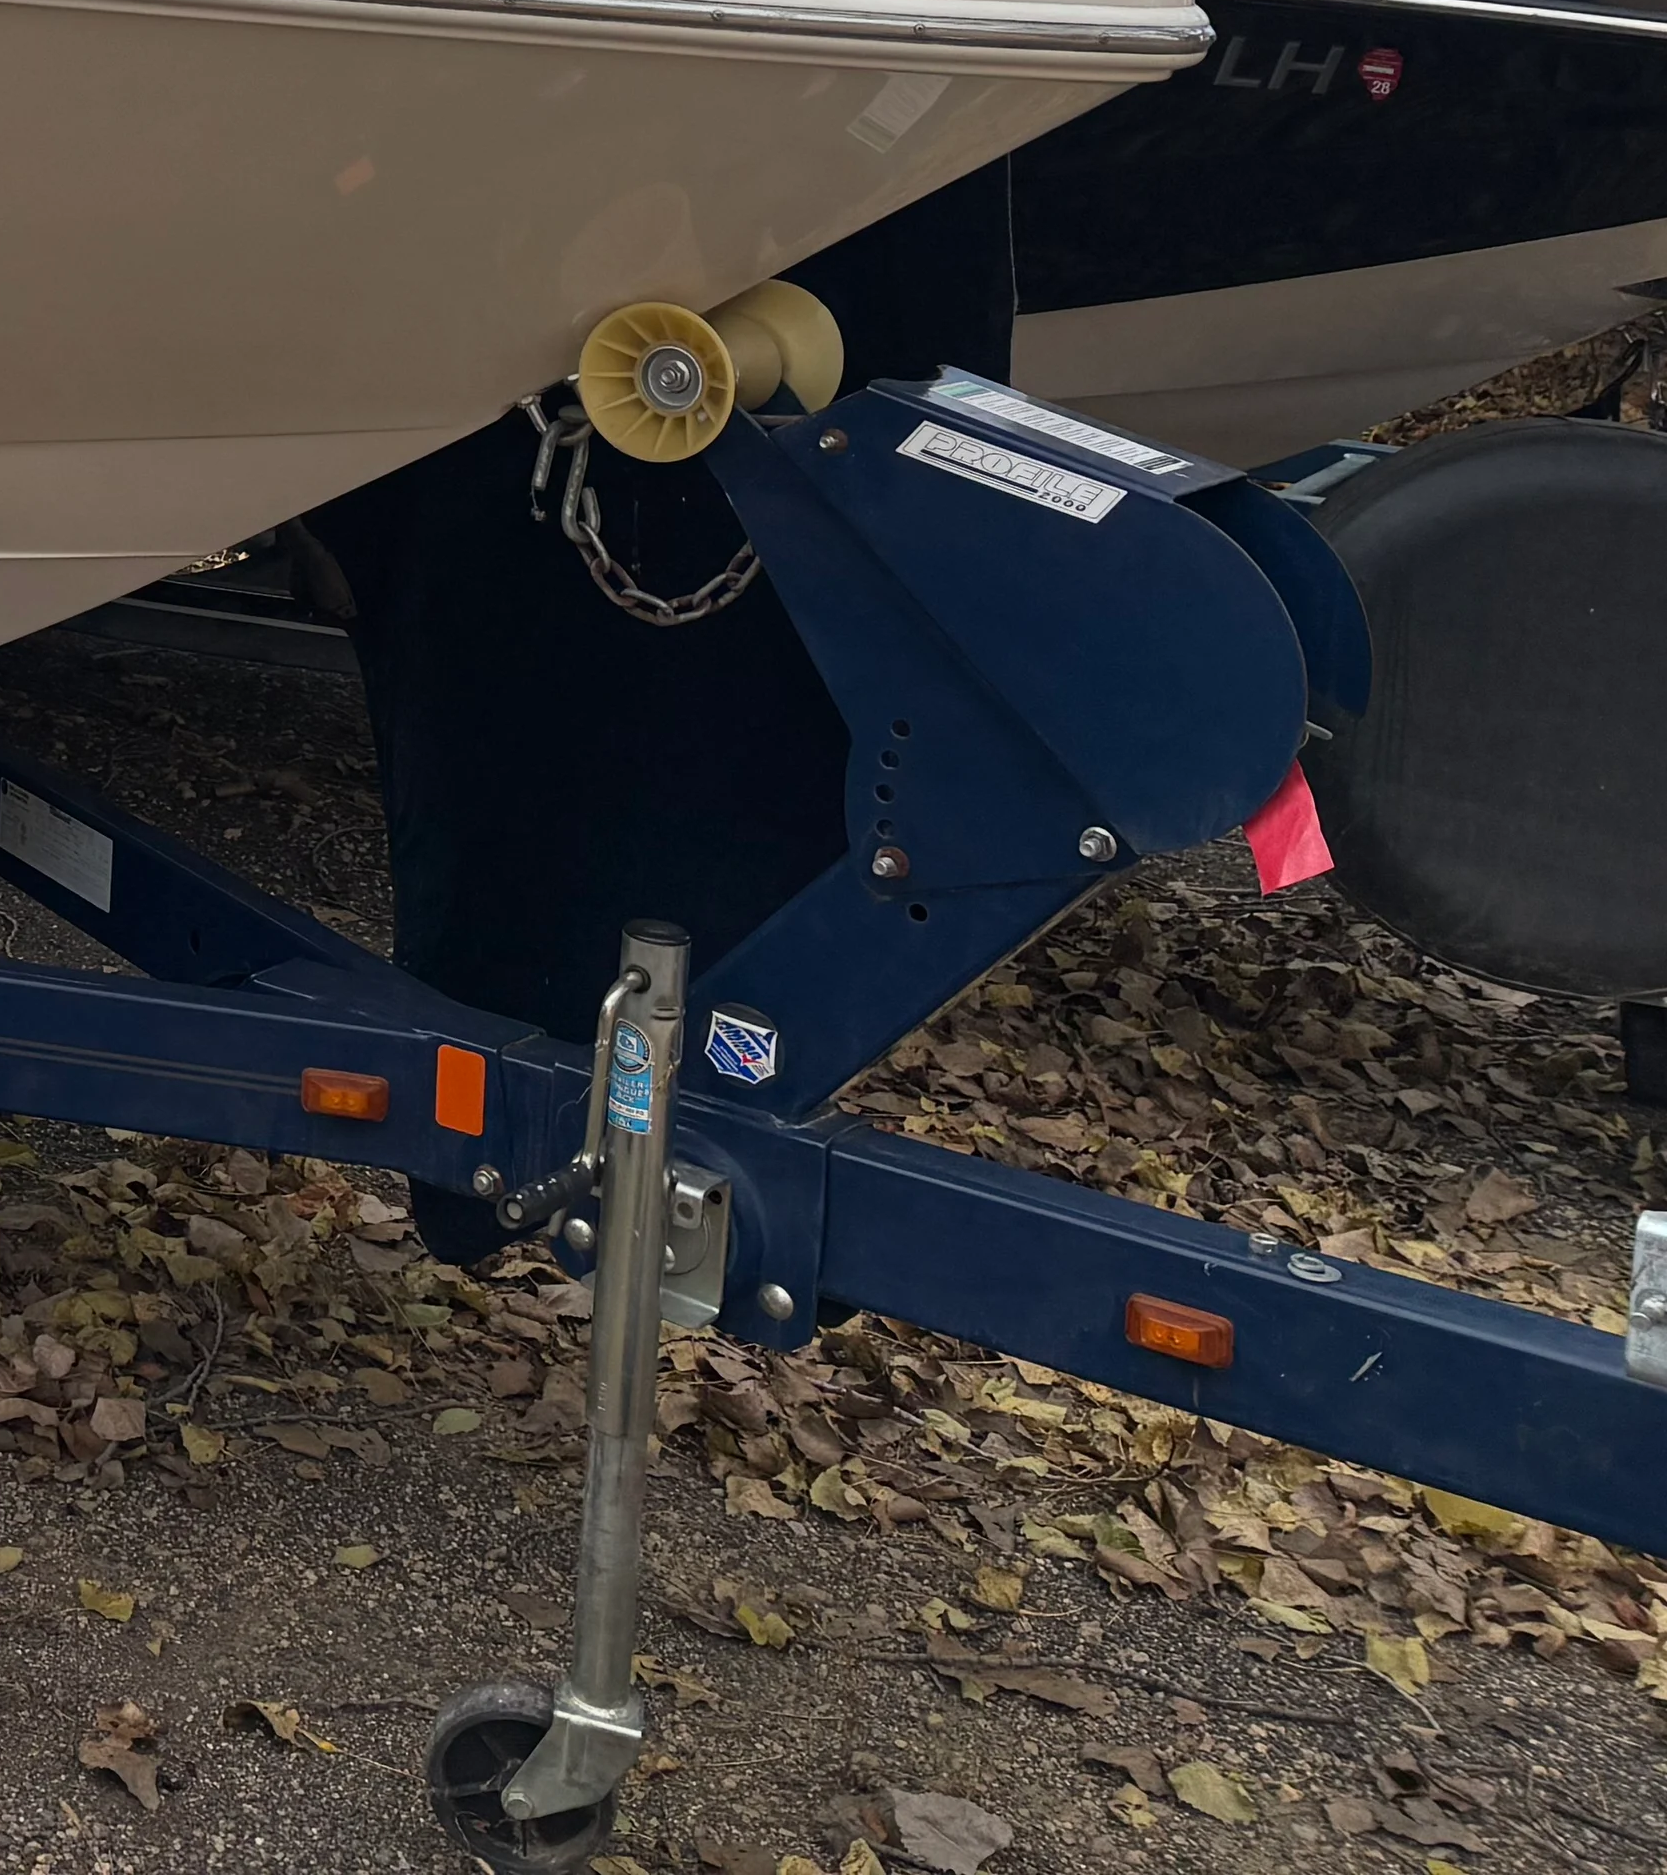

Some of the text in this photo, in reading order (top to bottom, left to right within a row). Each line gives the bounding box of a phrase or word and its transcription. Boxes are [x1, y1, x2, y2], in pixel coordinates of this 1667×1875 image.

[1213, 35, 1345, 94] LH
[1370, 80, 1391, 95] 28
[923, 432, 1104, 506] PROFILE
[1037, 491, 1087, 513] 2000
